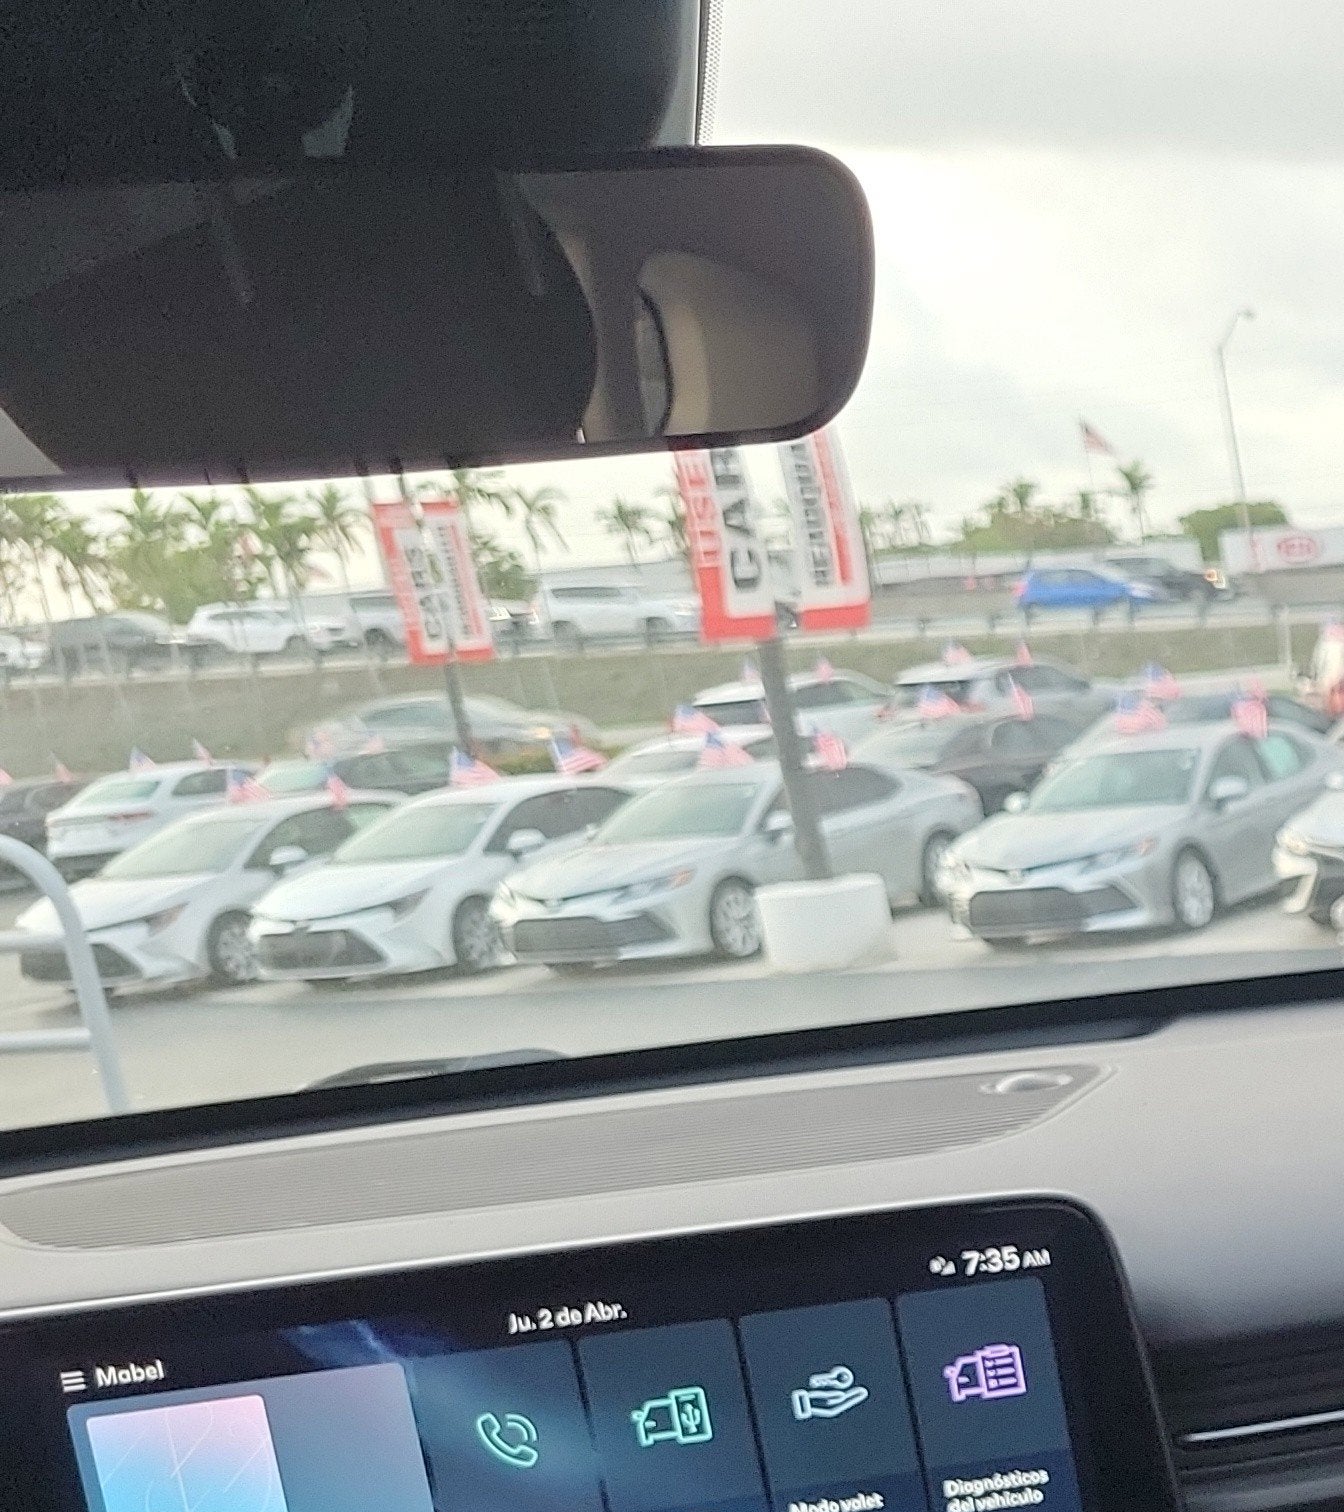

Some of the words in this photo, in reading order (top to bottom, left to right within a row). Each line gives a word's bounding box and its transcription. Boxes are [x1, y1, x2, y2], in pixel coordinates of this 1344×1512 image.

[961, 1245, 1020, 1276] 7:35
[1023, 1248, 1051, 1269] AM
[538, 1308, 554, 1328] 2
[556, 1306, 583, 1327] de
[585, 1300, 628, 1323] Abr.
[95, 1360, 165, 1388] Mabel
[942, 1468, 1049, 1499] Diagnósticos
